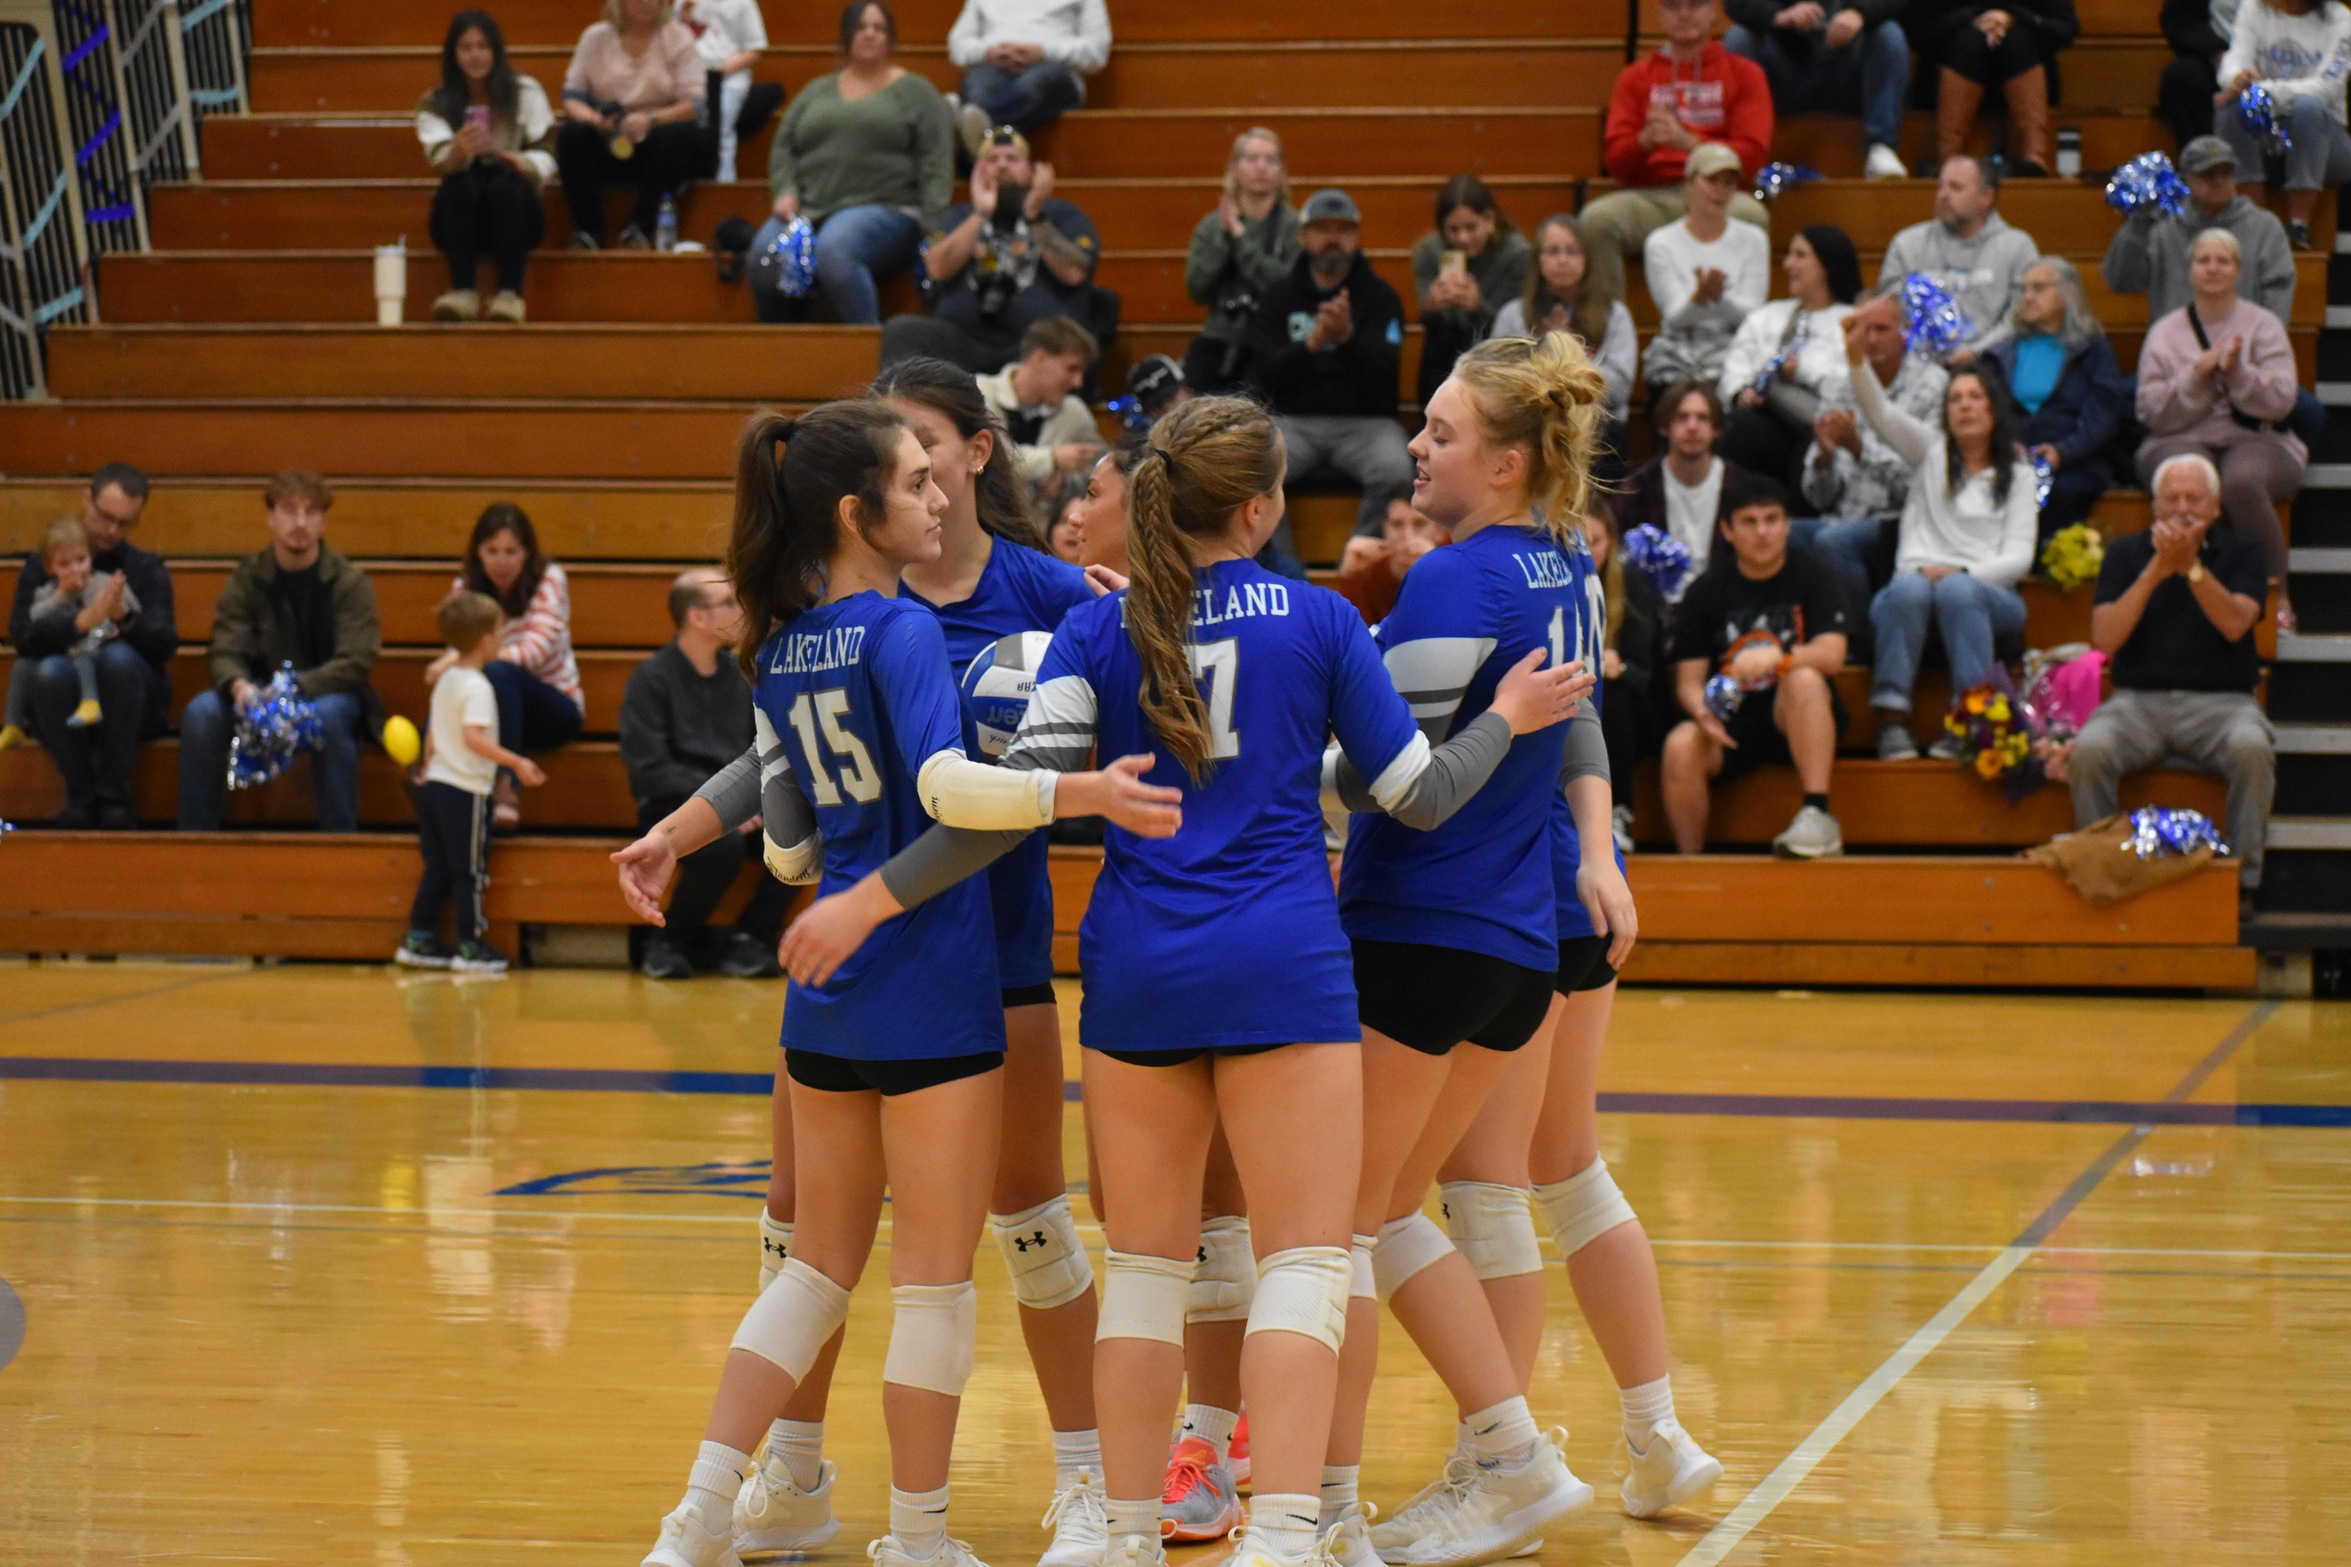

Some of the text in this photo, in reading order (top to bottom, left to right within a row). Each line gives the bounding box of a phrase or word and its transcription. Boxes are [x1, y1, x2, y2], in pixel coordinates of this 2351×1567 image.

[1118, 583, 1290, 628] ELAND
[770, 625, 866, 675] LAKELAND
[1182, 635, 1241, 760] 7
[787, 686, 883, 806] 15
